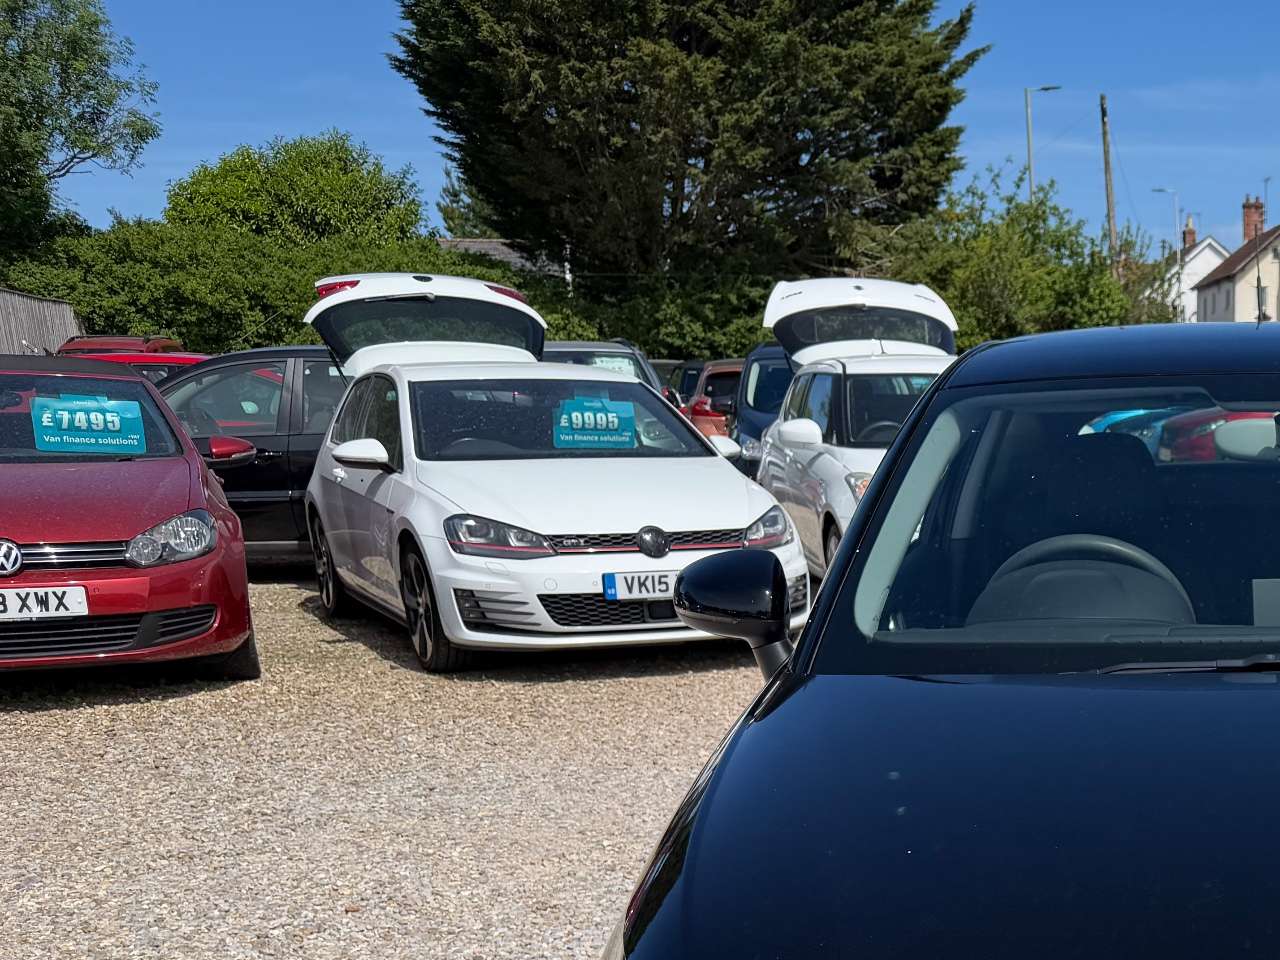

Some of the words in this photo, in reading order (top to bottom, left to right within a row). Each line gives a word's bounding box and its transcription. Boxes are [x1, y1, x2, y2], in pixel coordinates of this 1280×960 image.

[41, 410, 120, 431] £7495
[560, 412, 619, 430] £9995
[43, 434, 61, 443] Van
[63, 435, 96, 444] finance
[98, 436, 138, 446] solutions
[574, 433, 599, 441] finance
[600, 433, 630, 442] solutions
[623, 574, 670, 594] VK15
[16, 590, 70, 613] XWX
